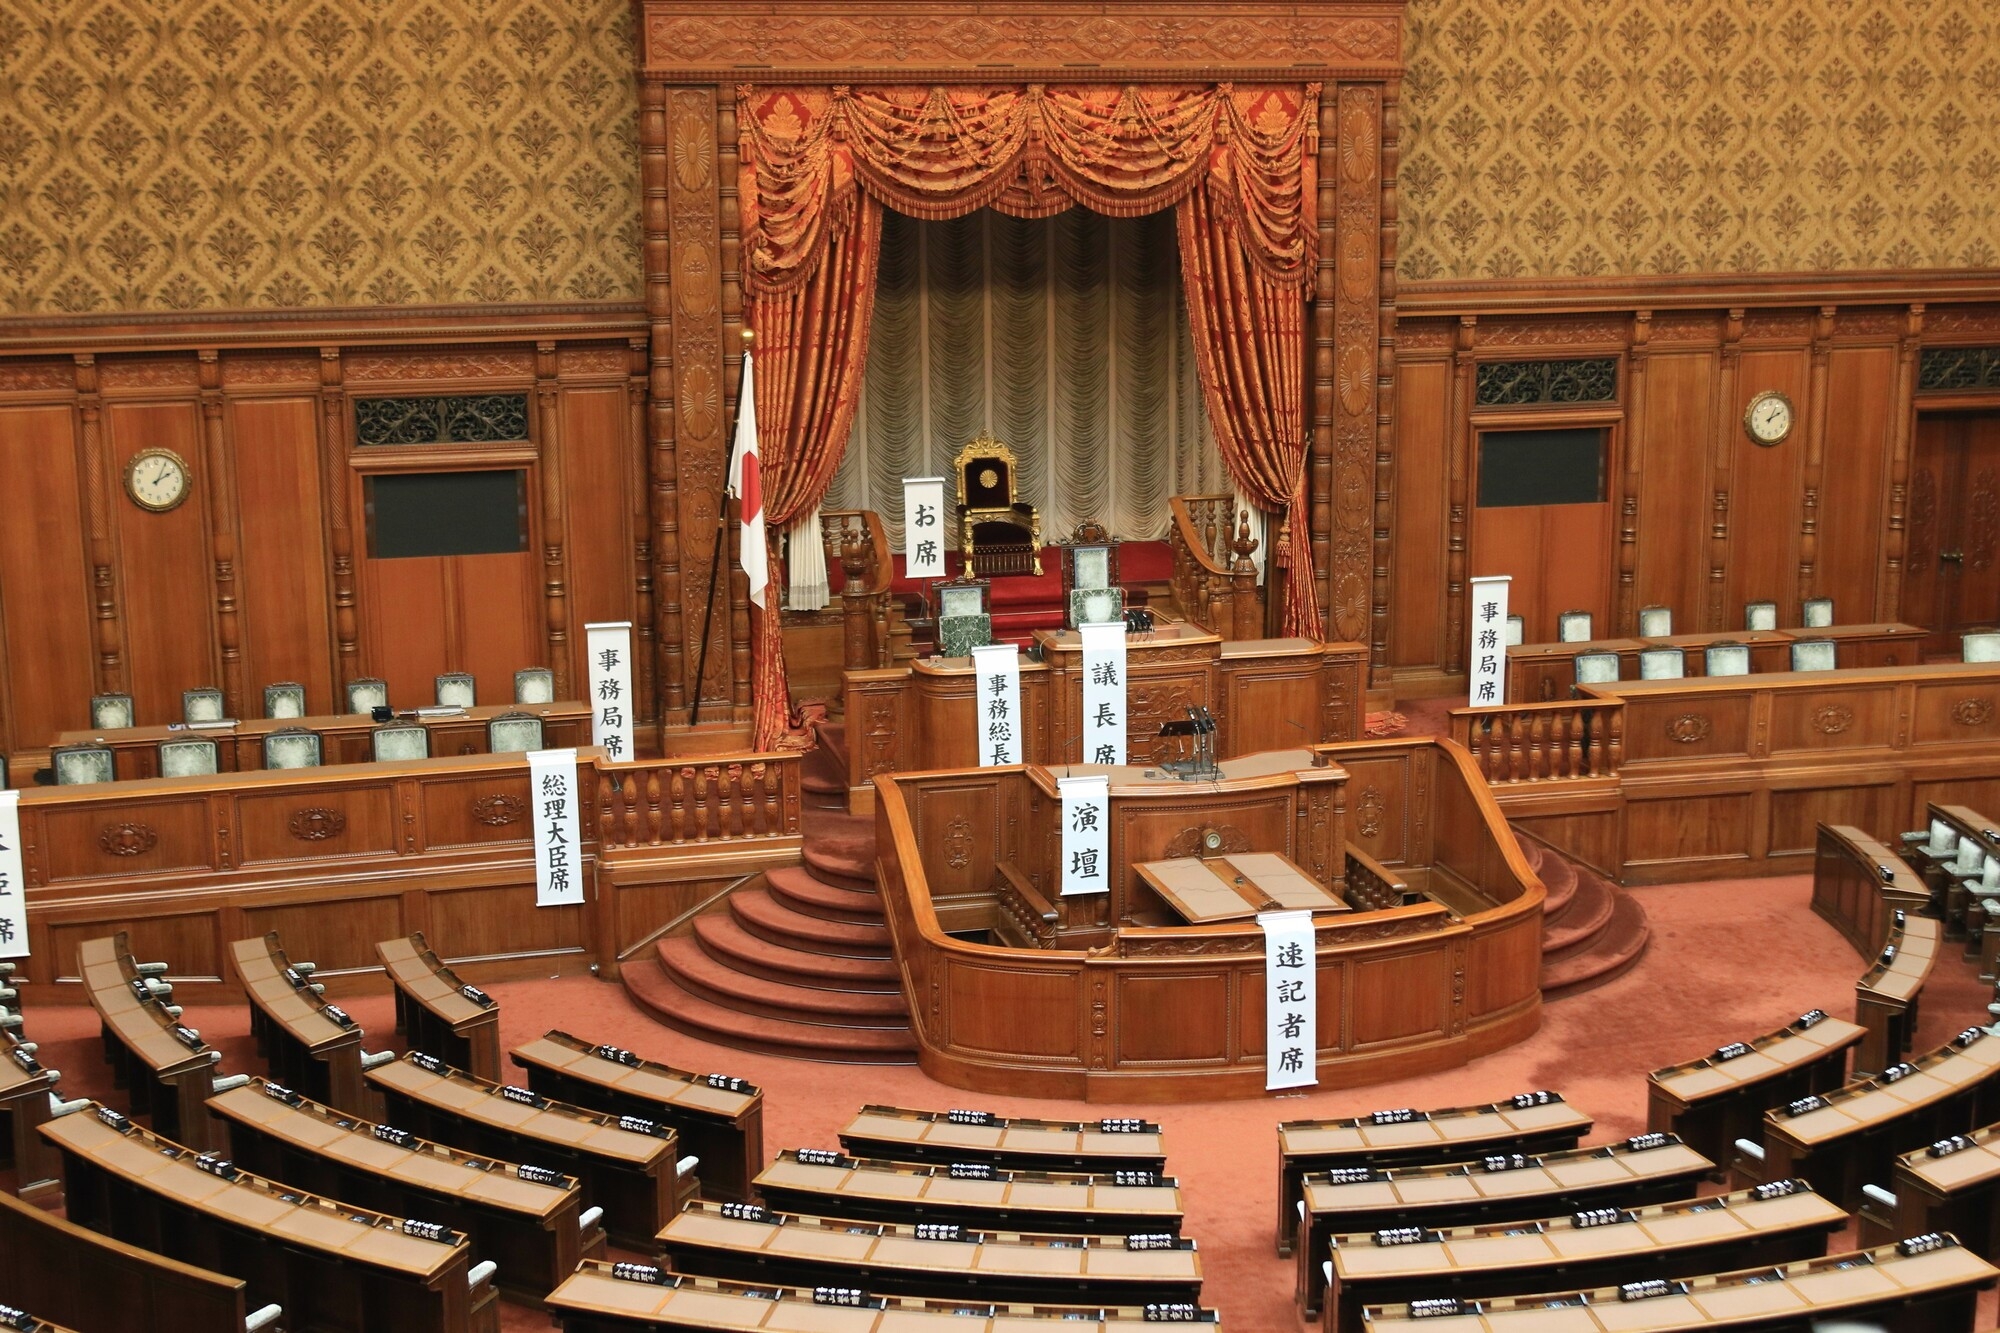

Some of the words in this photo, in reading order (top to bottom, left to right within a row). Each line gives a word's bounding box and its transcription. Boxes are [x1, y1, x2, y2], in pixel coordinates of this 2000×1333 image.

[914, 504, 938, 567] お席
[1477, 602, 1499, 702] 事務局席
[597, 649, 623, 758] 事務局席
[988, 674, 1012, 766] 事務総長
[1091, 661, 1118, 765] 議長席
[542, 774, 569, 893] 総理大臣席
[1070, 802, 1100, 879] 演壇
[1275, 942, 1307, 1074] 速記者席
